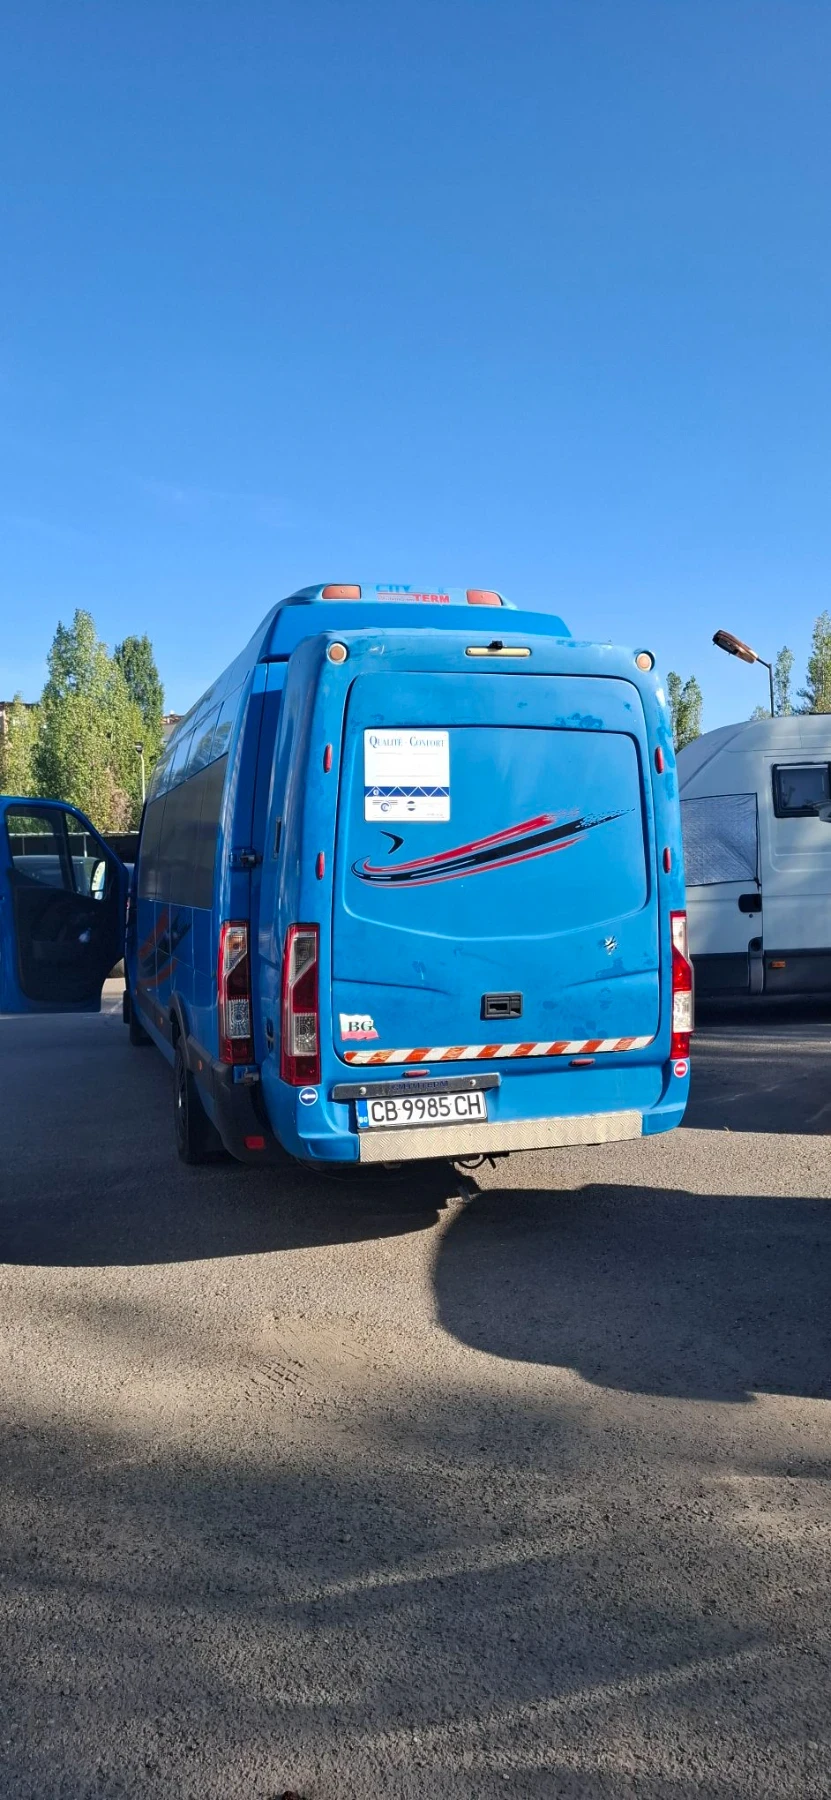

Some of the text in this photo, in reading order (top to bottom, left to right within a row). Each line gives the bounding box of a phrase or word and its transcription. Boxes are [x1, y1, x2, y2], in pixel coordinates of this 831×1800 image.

[376, 584, 411, 593] CITY
[413, 594, 450, 603] TERM
[348, 1020, 373, 1032] BG
[371, 1095, 481, 1122] CB 9985 CH
